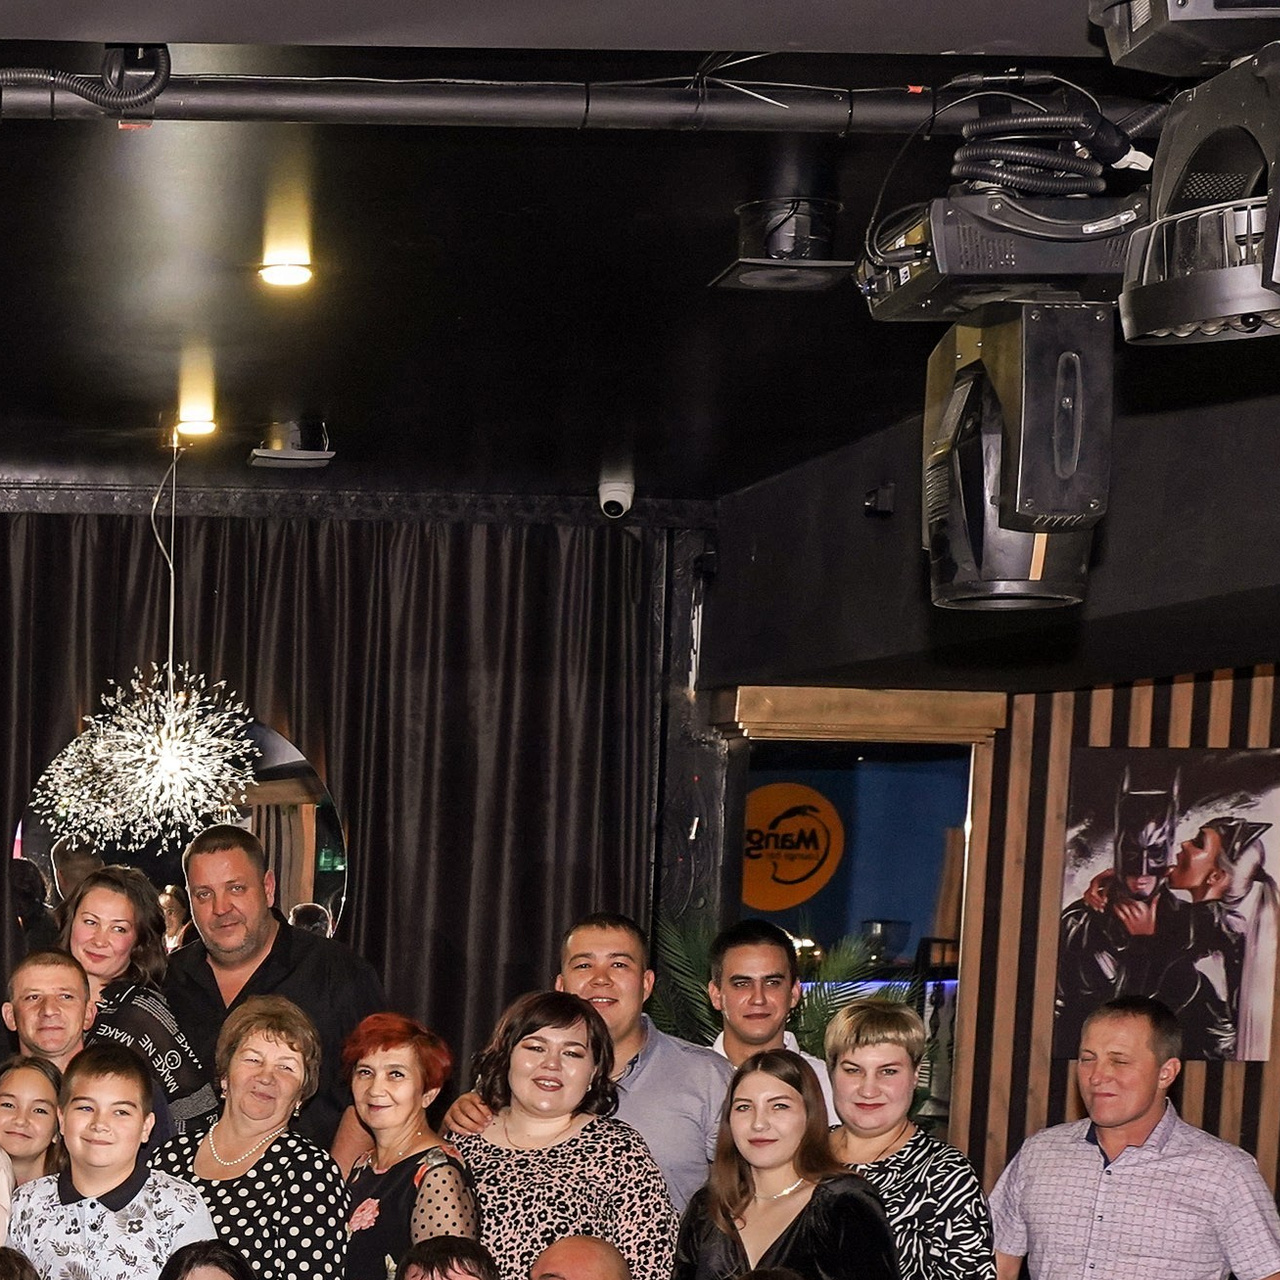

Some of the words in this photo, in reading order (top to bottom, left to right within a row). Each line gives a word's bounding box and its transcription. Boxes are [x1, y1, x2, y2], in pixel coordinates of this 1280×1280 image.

[96, 1023, 134, 1047] MAKE
[138, 1033, 156, 1057] NE
[152, 1054, 179, 1093] MAKE
